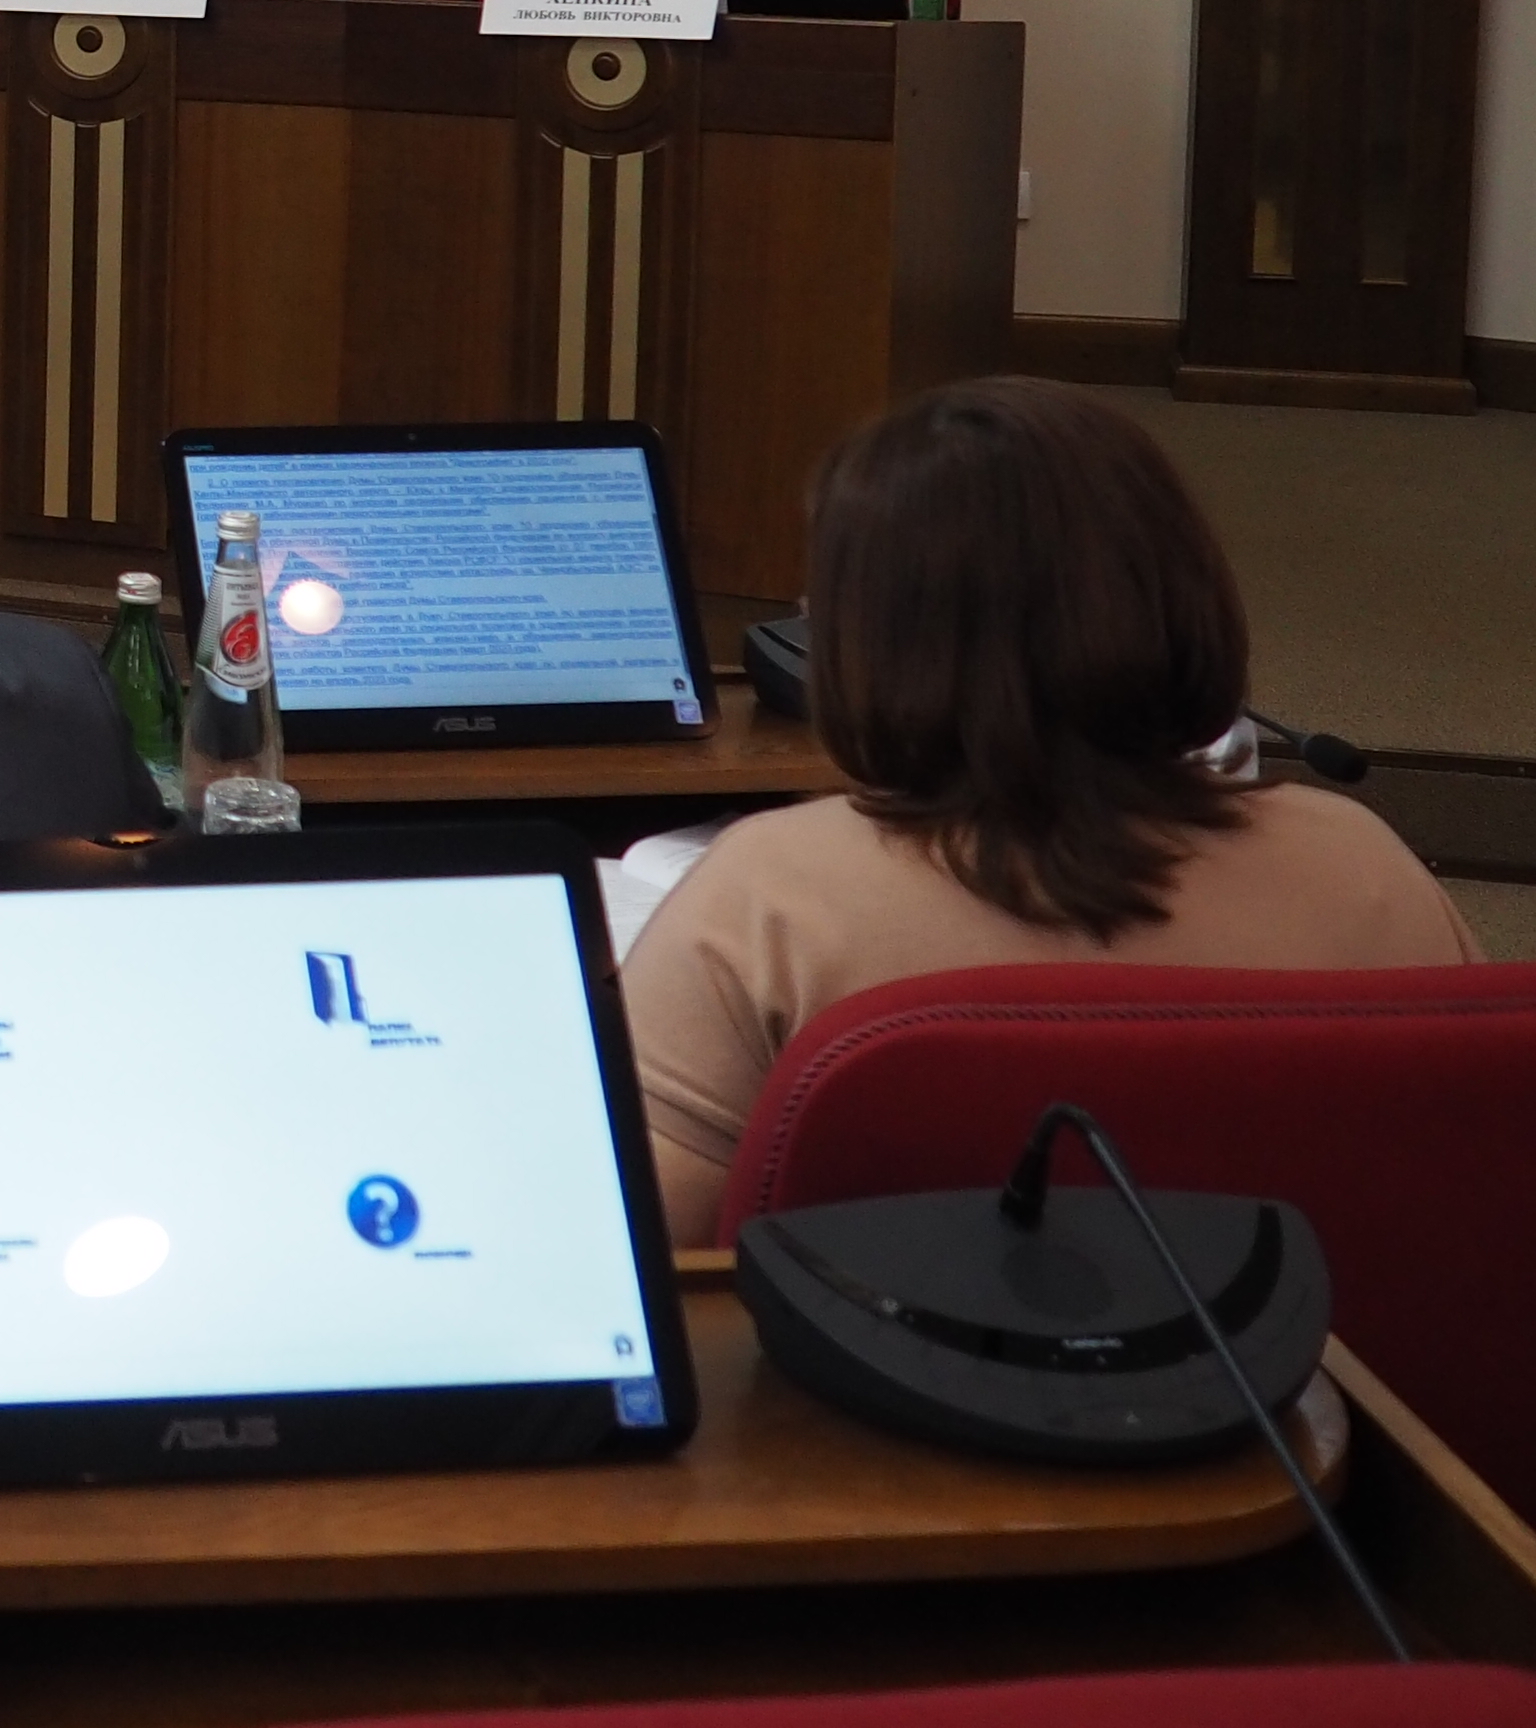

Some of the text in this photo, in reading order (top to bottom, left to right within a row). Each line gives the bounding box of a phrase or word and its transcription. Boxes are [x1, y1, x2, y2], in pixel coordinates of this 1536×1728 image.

[512, 9, 682, 24] ЛЮБОВЬ ВИКТОРОВНА
[431, 716, 497, 732] ASUS
